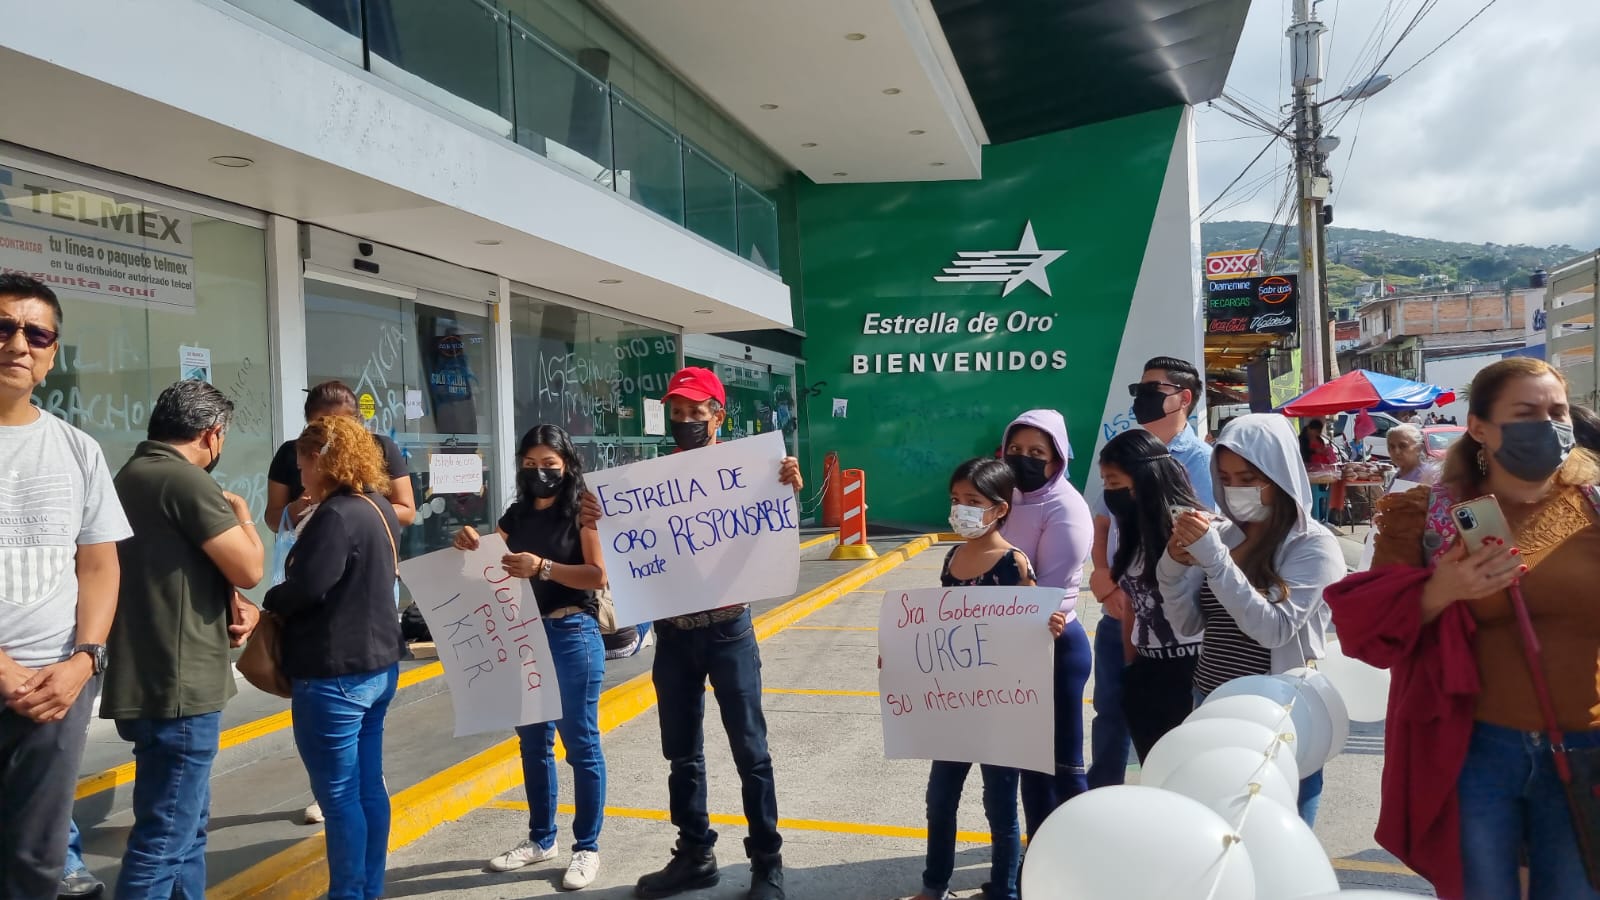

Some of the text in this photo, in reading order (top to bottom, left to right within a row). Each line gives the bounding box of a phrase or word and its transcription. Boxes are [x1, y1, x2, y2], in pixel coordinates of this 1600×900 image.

[24, 184, 183, 244] TELMEX
[49, 235, 187, 275] tu línea o paquete telmex
[1208, 254, 1259, 274] OXXO
[51, 259, 61, 268] en
[64, 260, 73, 271] tu
[76, 263, 126, 280] distribuidor
[128, 272, 170, 288] autorizado
[108, 283, 157, 298] aquí
[863, 310, 1054, 335] Estrella de Oro
[853, 350, 1068, 375] BIENVENIDOS
[597, 466, 747, 517] ESTRELLA DE
[613, 496, 797, 556] ORO RESPONSABLE
[629, 553, 667, 579] hazte
[898, 591, 1040, 629] Sra. Gobernadora
[431, 593, 495, 689] IKER
[915, 624, 998, 674] URGE
[923, 677, 1039, 712] intervención
